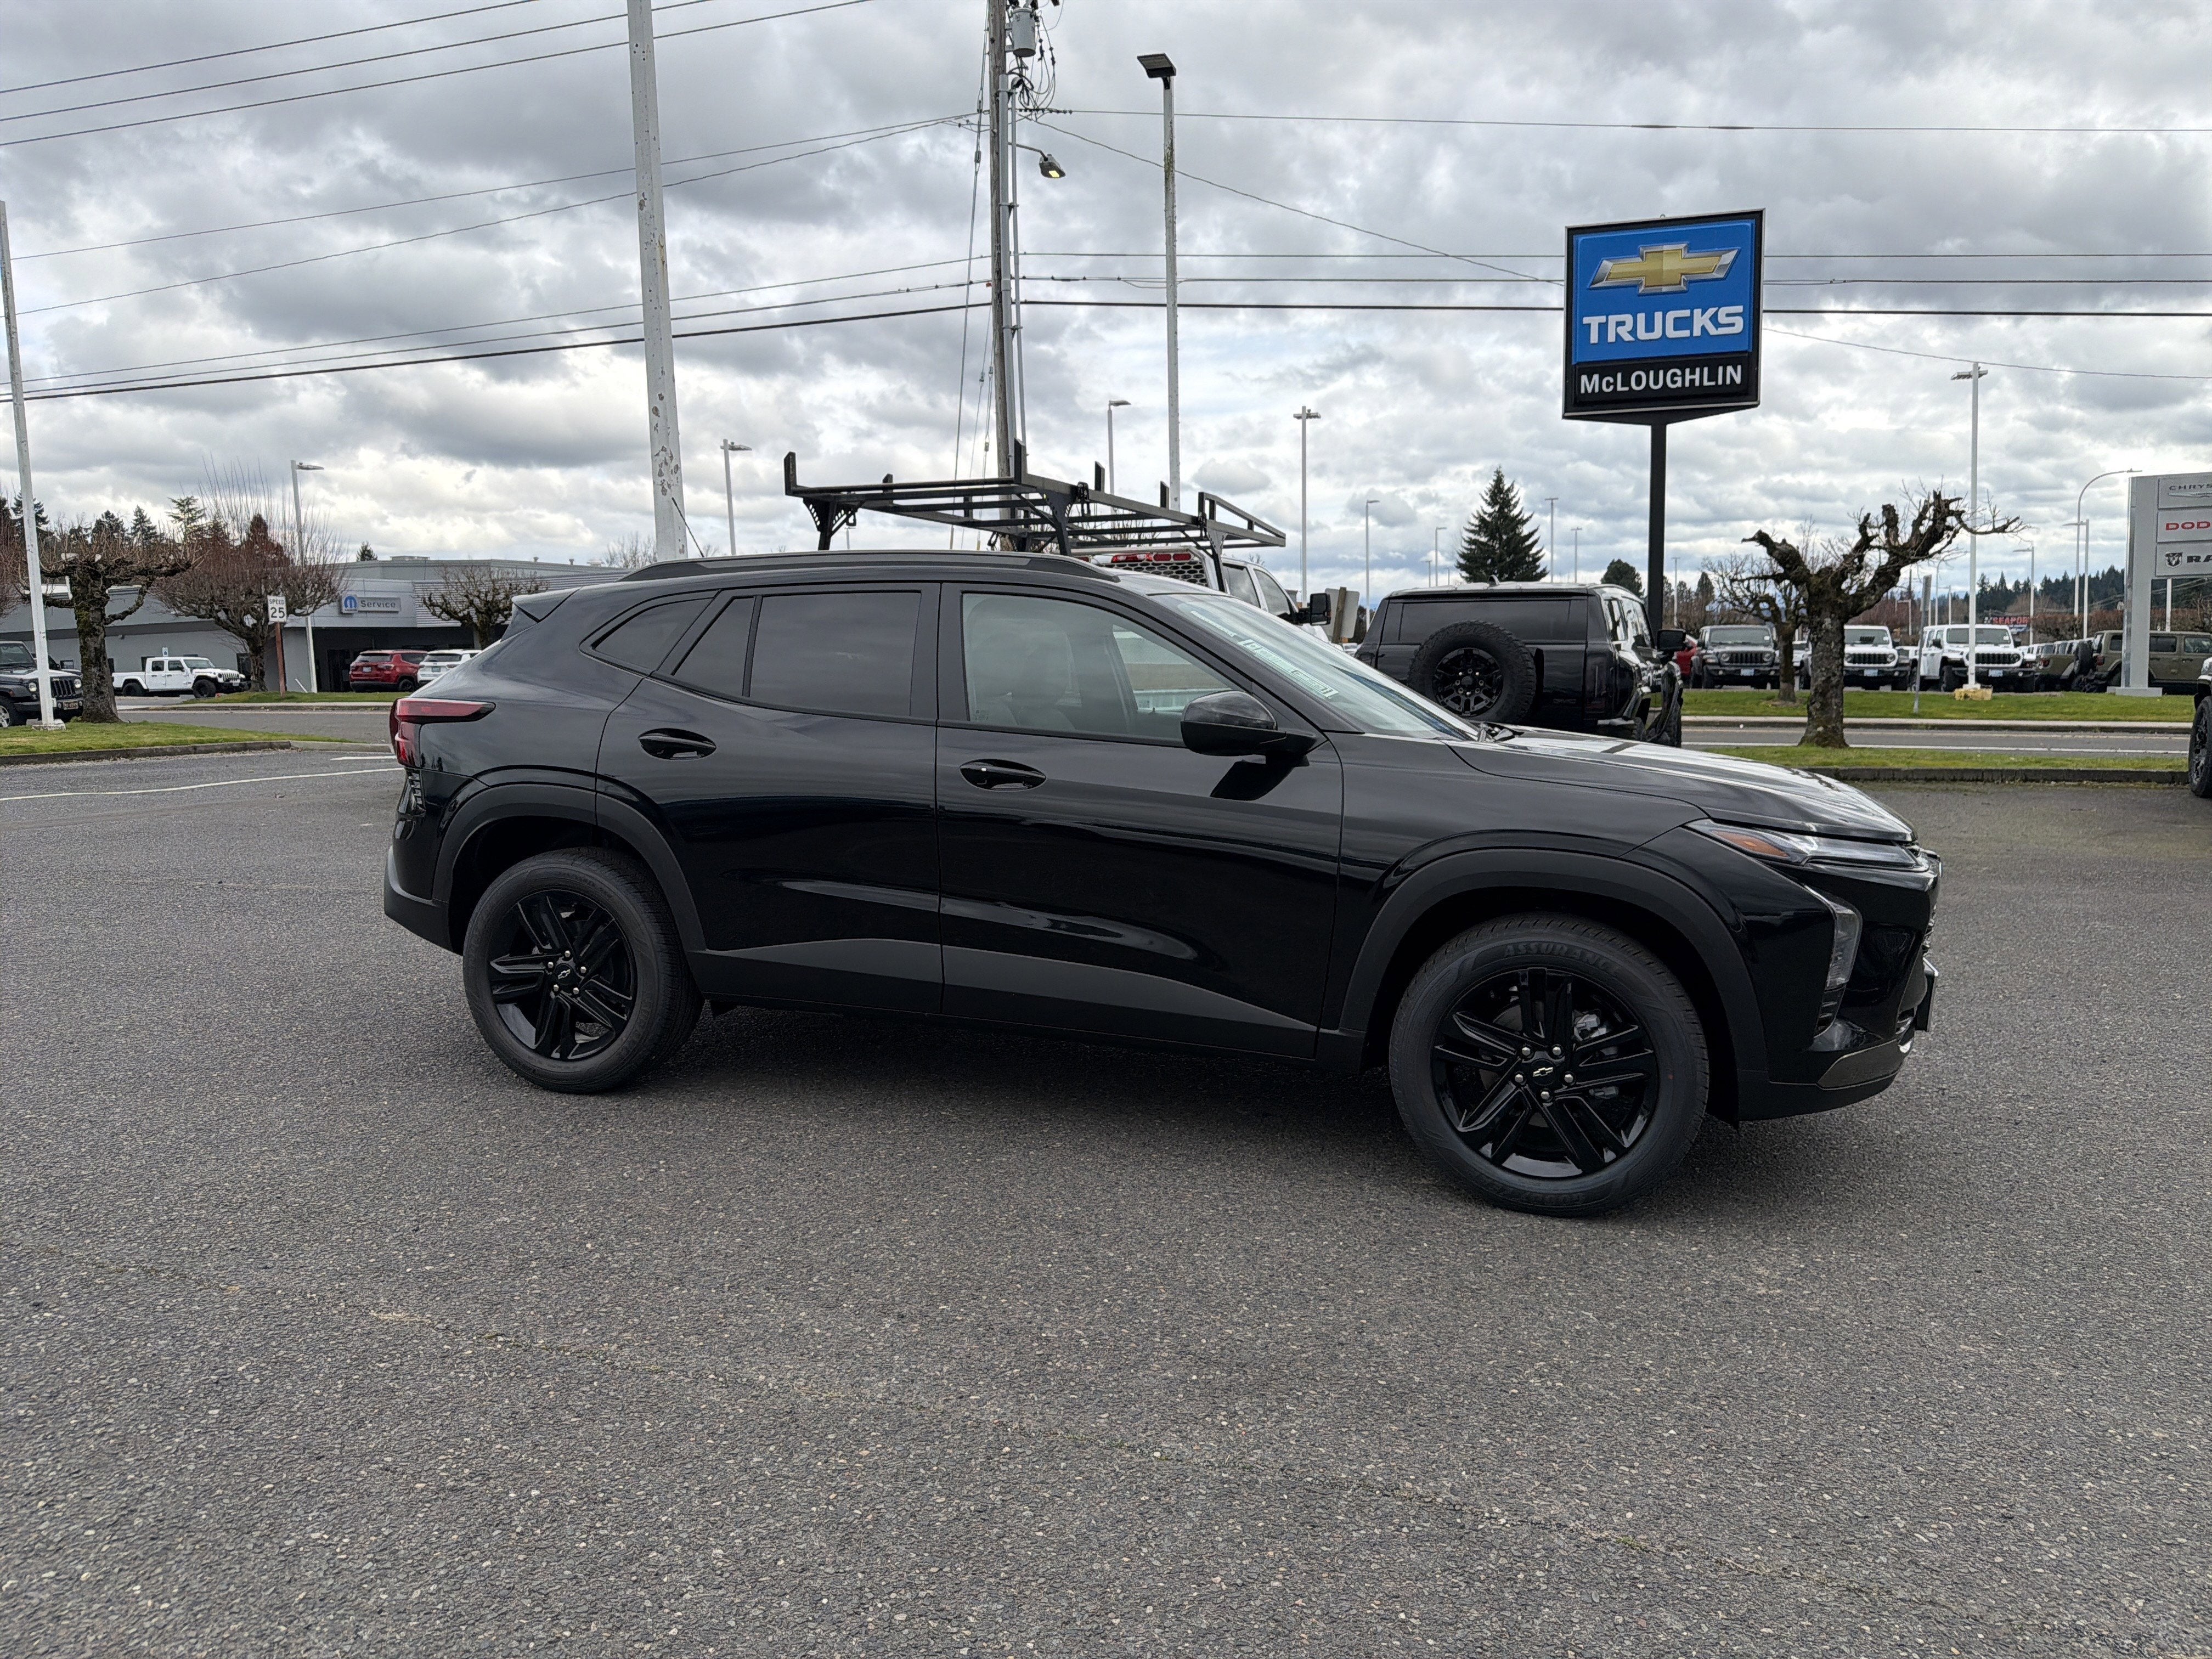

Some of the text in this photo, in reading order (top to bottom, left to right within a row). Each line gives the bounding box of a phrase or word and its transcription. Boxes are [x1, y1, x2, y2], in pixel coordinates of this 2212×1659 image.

[1583, 305, 1743, 344] TRUCKS
[1580, 364, 1742, 394] McLOUGHLIN
[270, 606, 285, 618] 25
[360, 600, 396, 608] Service
